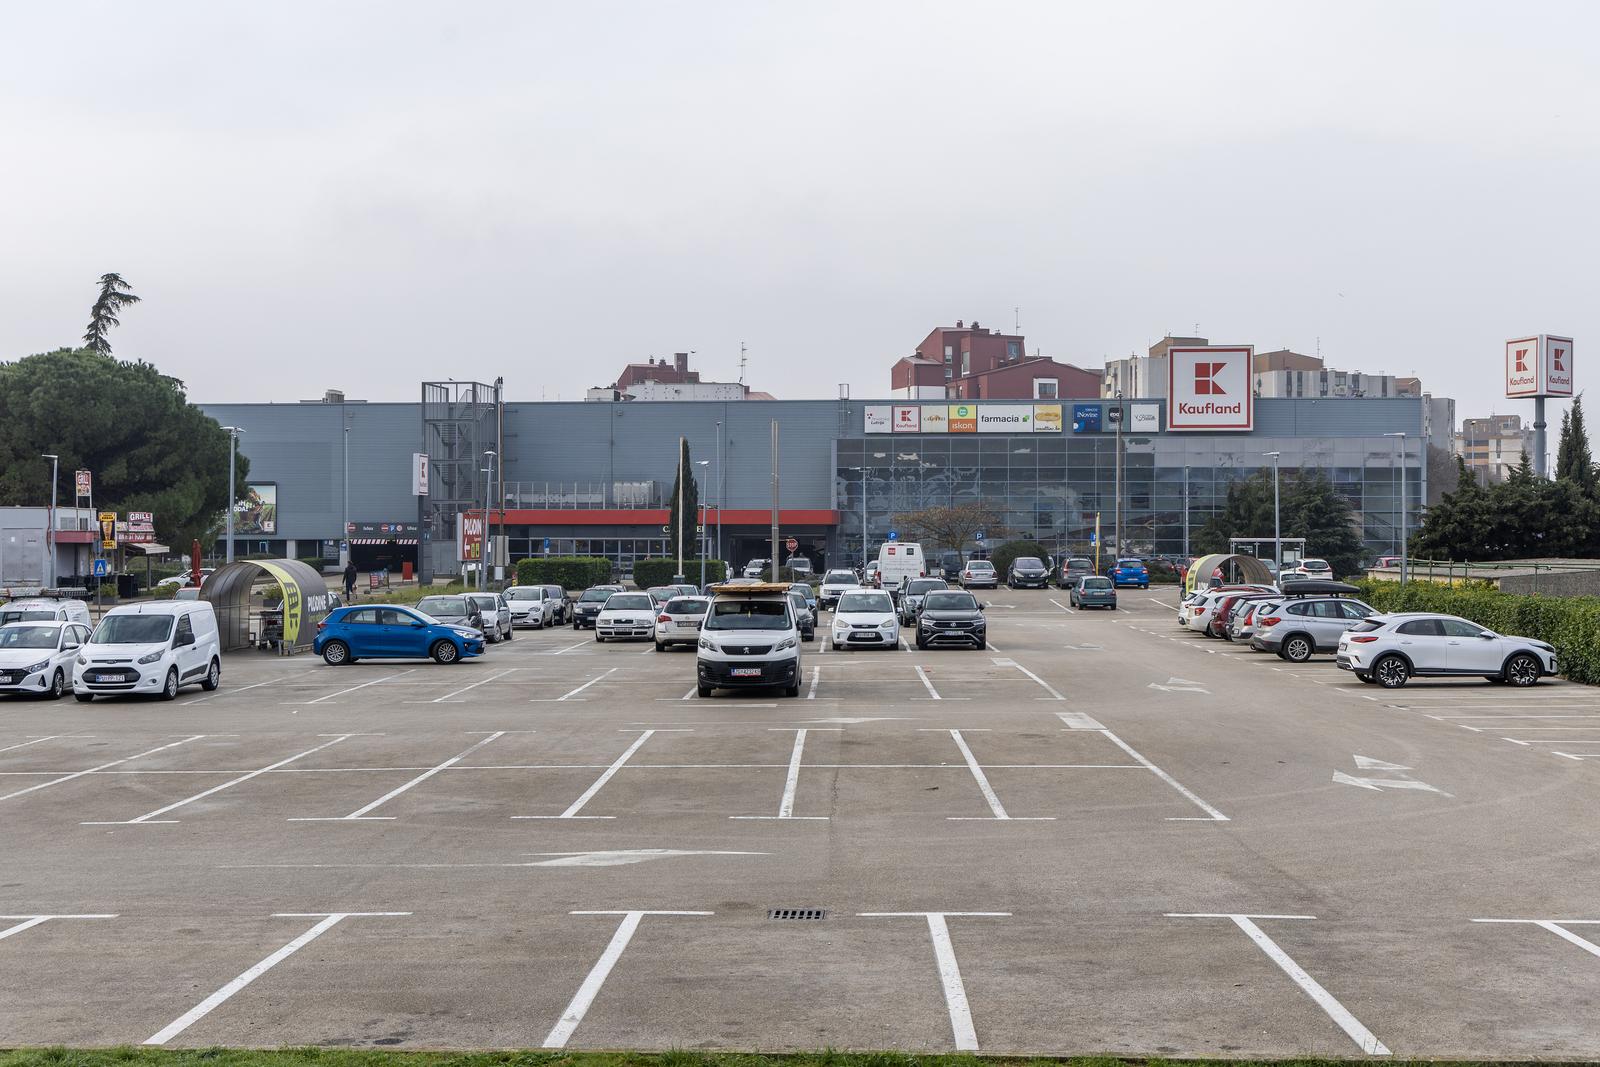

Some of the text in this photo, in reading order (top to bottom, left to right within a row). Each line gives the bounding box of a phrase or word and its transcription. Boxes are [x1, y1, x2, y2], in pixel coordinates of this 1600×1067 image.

[1510, 376, 1534, 386] Kaufland
[1549, 376, 1569, 385] Kaufland
[1179, 402, 1241, 414] Kaufland
[981, 415, 1019, 423] farmacia
